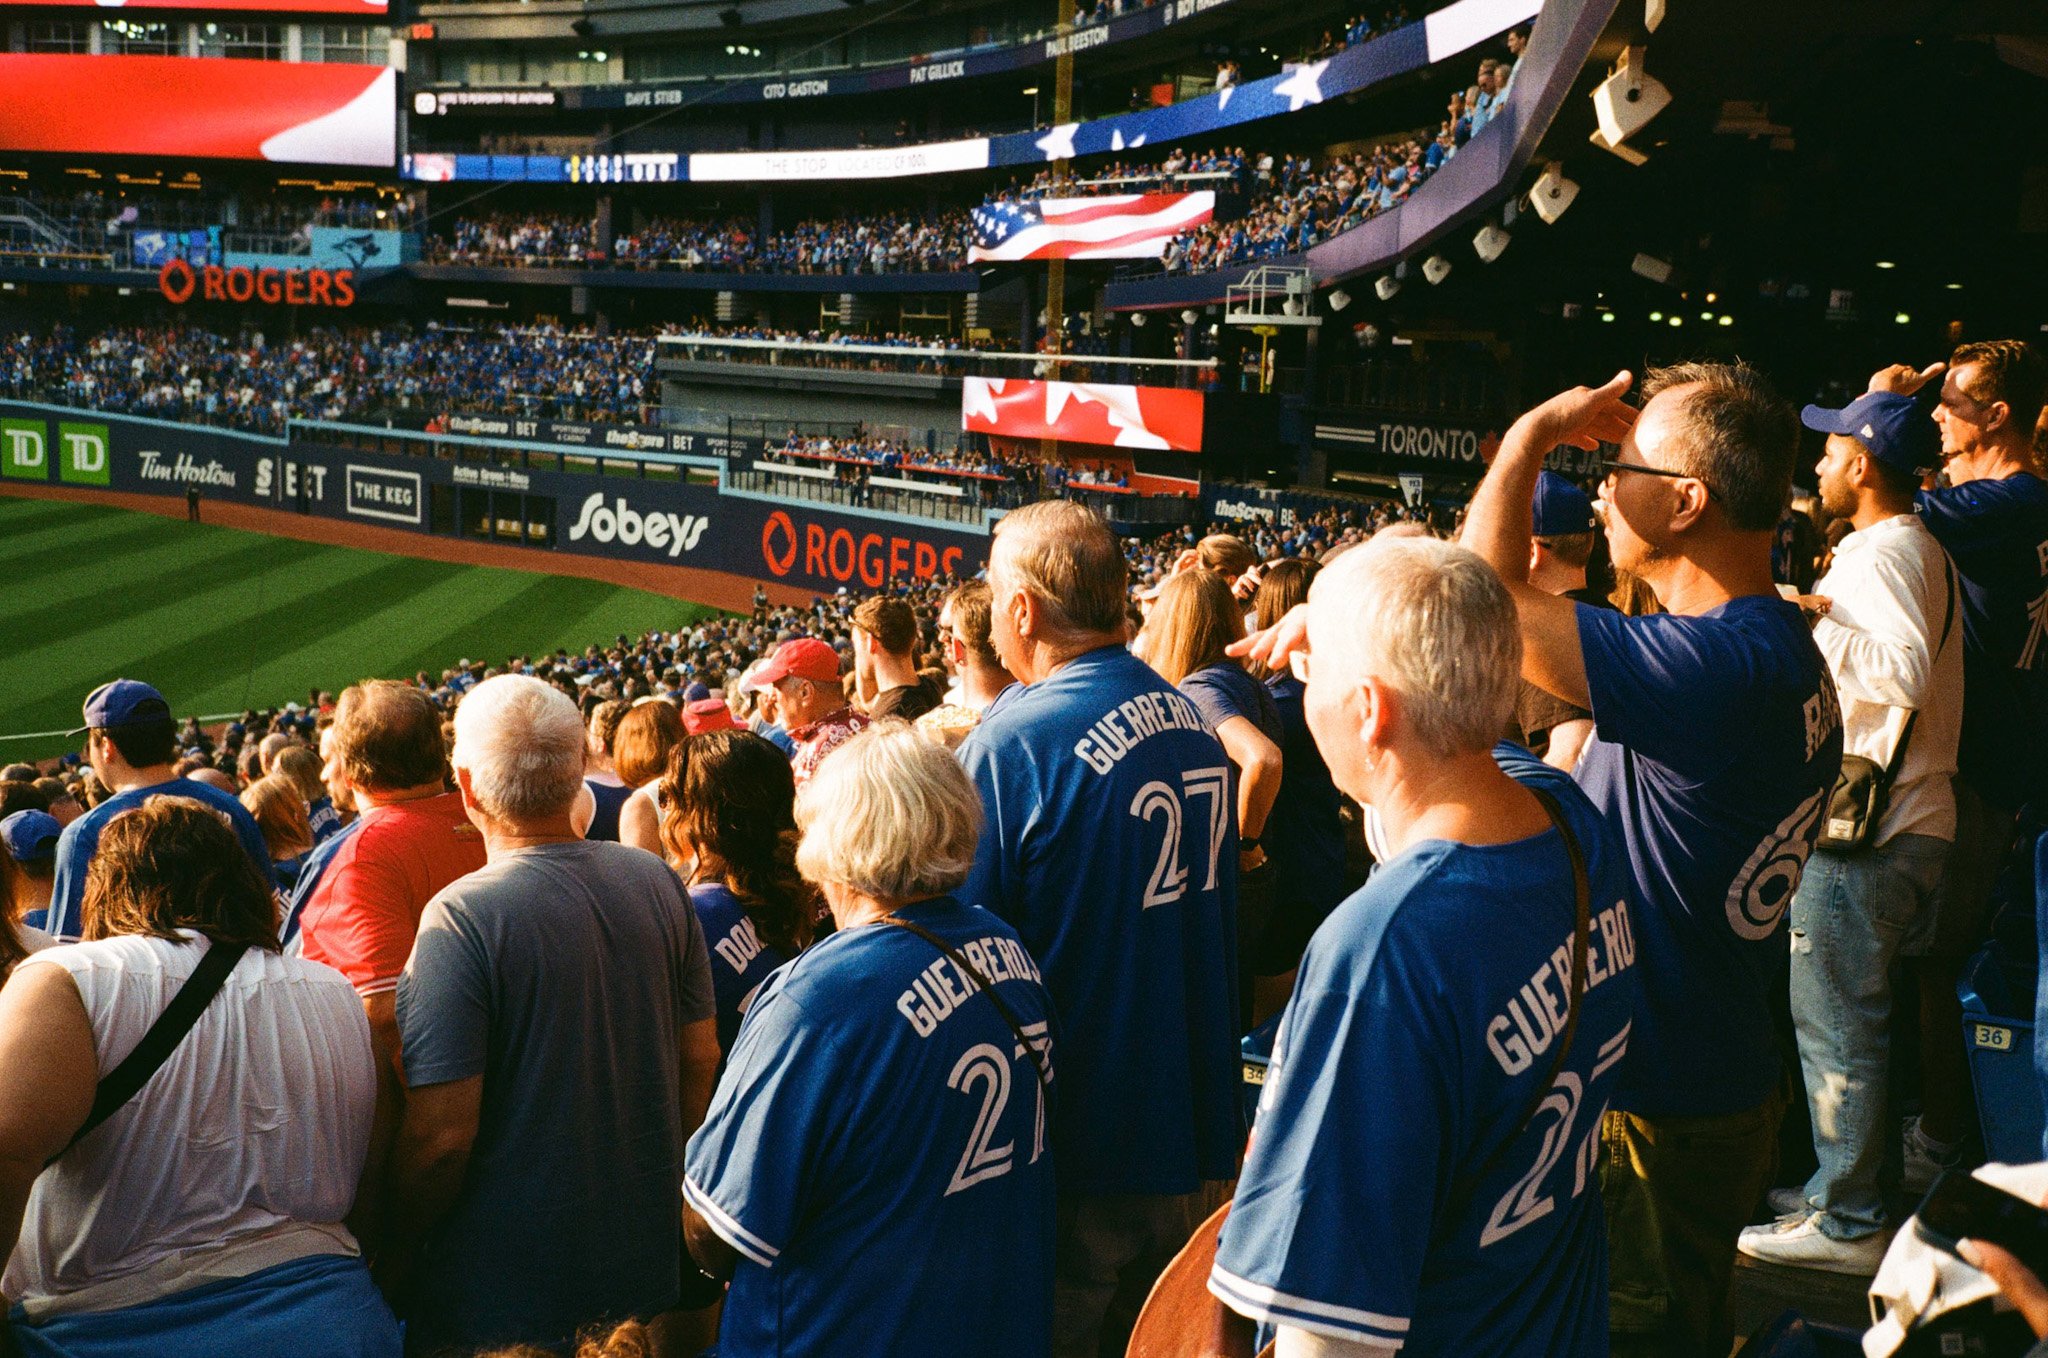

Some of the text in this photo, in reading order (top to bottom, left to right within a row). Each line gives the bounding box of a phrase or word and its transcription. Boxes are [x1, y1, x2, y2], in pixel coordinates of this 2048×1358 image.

[763, 80, 829, 99] CITO GASTON
[910, 60, 965, 83] PAT GILLICK
[204, 264, 355, 307] ROGERS
[515, 421, 537, 437] BET
[673, 435, 693, 450] BET
[1381, 424, 1477, 461] TORONTO
[5, 429, 44, 467] TD
[64, 433, 104, 471] TD
[139, 451, 236, 488] Tim Hortons
[355, 481, 413, 507] THE KEG
[569, 492, 709, 557] Sobeys
[1074, 691, 1201, 776] GUERRERO
[1129, 766, 1229, 912] 27
[1979, 1028, 2003, 1045] 36
[1247, 1066, 1263, 1081] 34
[944, 1020, 1054, 1198] 27
